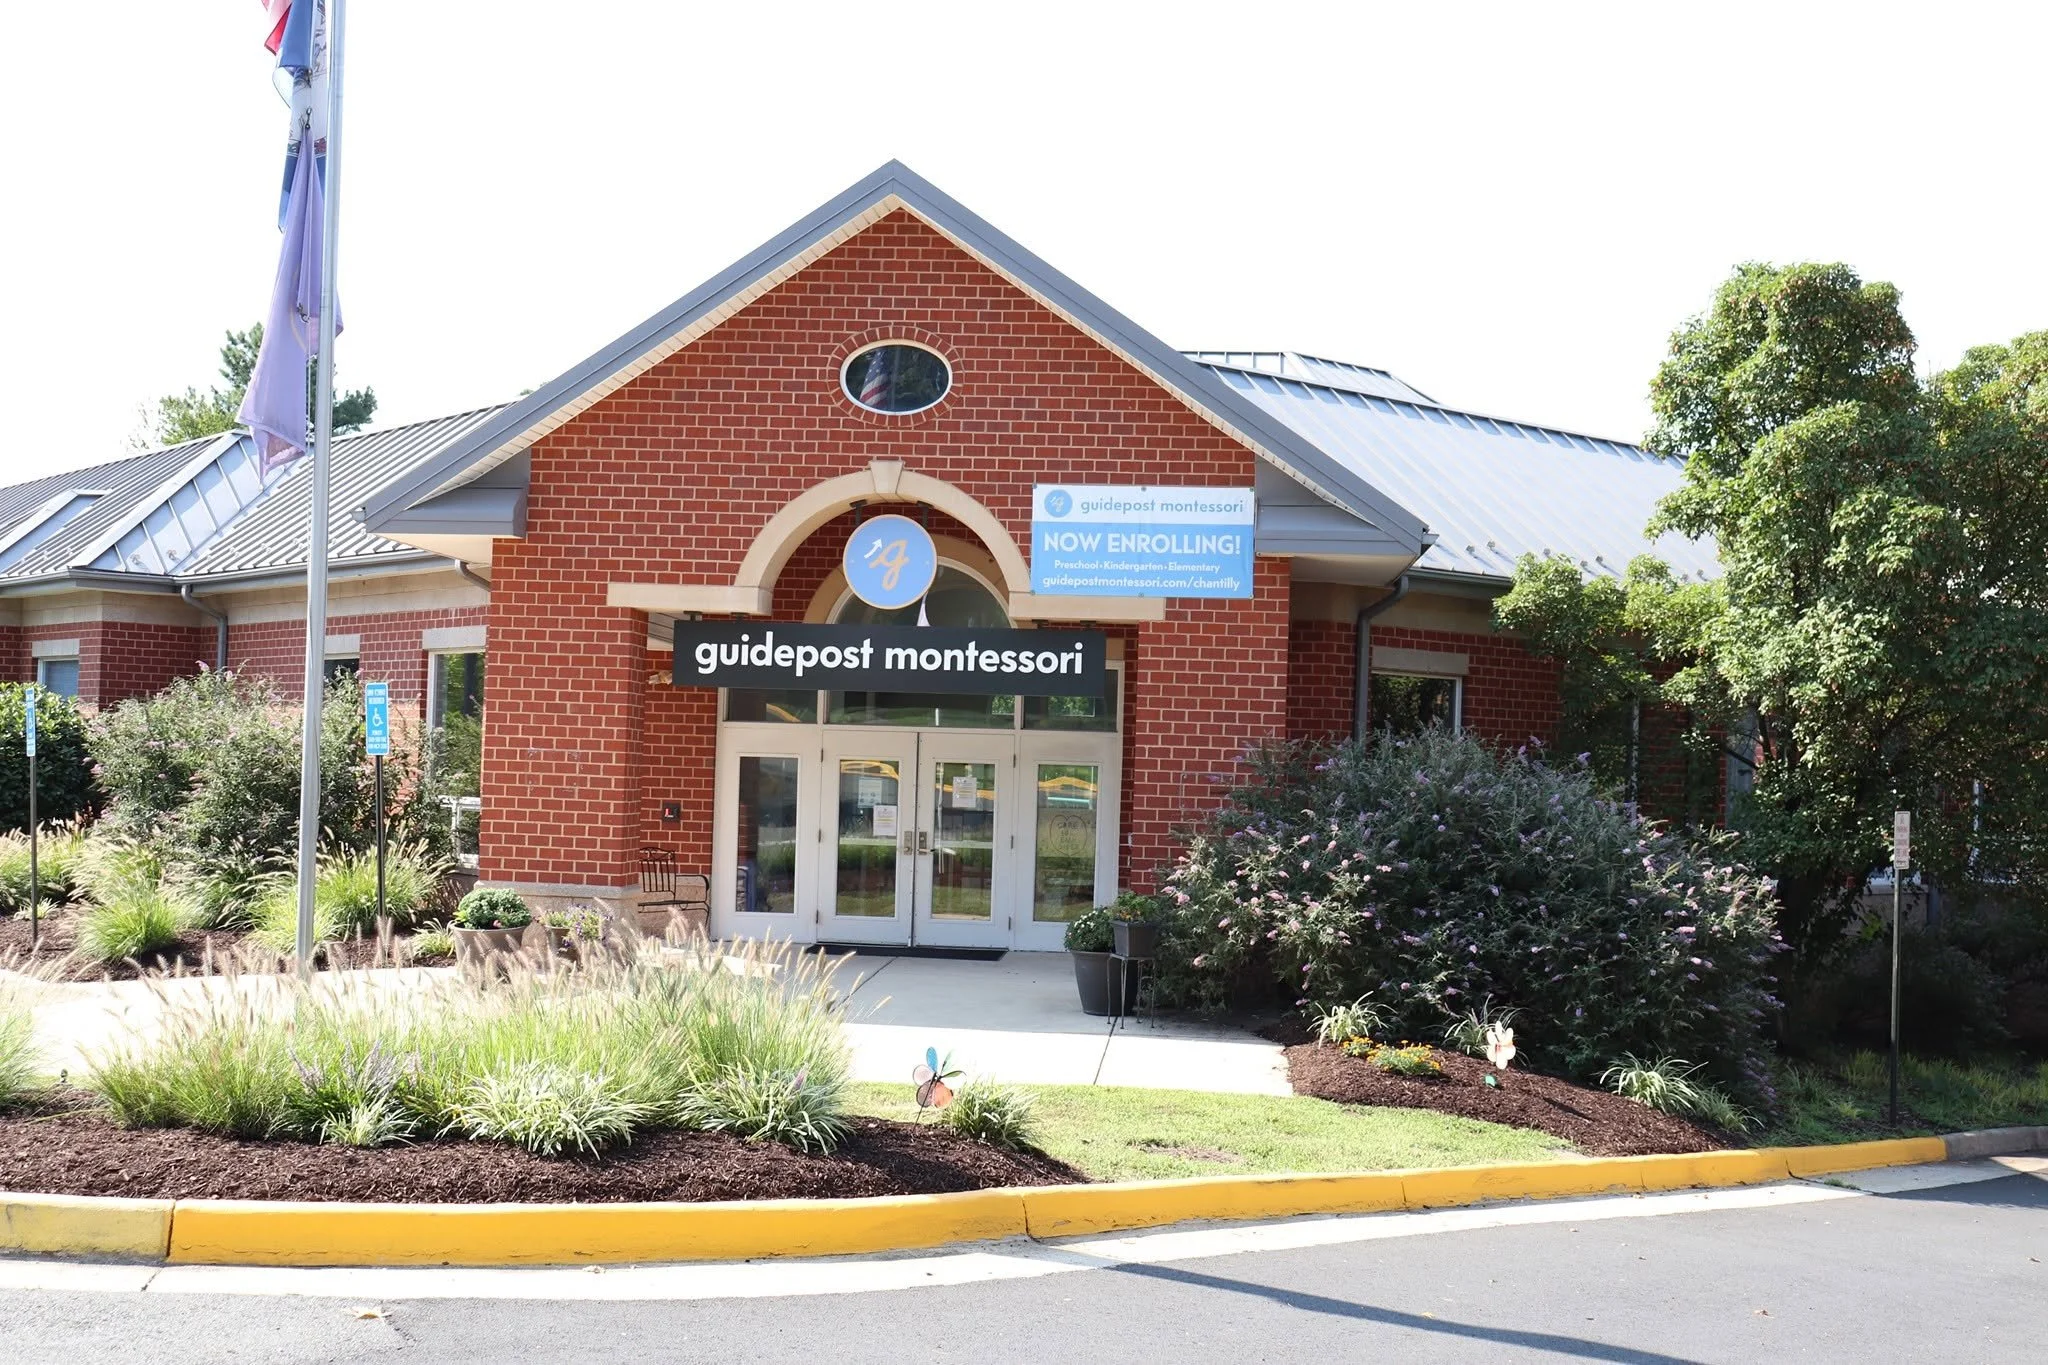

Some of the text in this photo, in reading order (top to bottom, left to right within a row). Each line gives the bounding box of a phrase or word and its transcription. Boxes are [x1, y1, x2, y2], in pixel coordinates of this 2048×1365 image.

[1080, 497, 1244, 514] guidepost montessori
[1043, 533, 1241, 555] NOW ENROLLING!
[1043, 576, 1240, 591] guidepostmontessori.com/chantilly
[695, 630, 1084, 677] guidepost montessori
